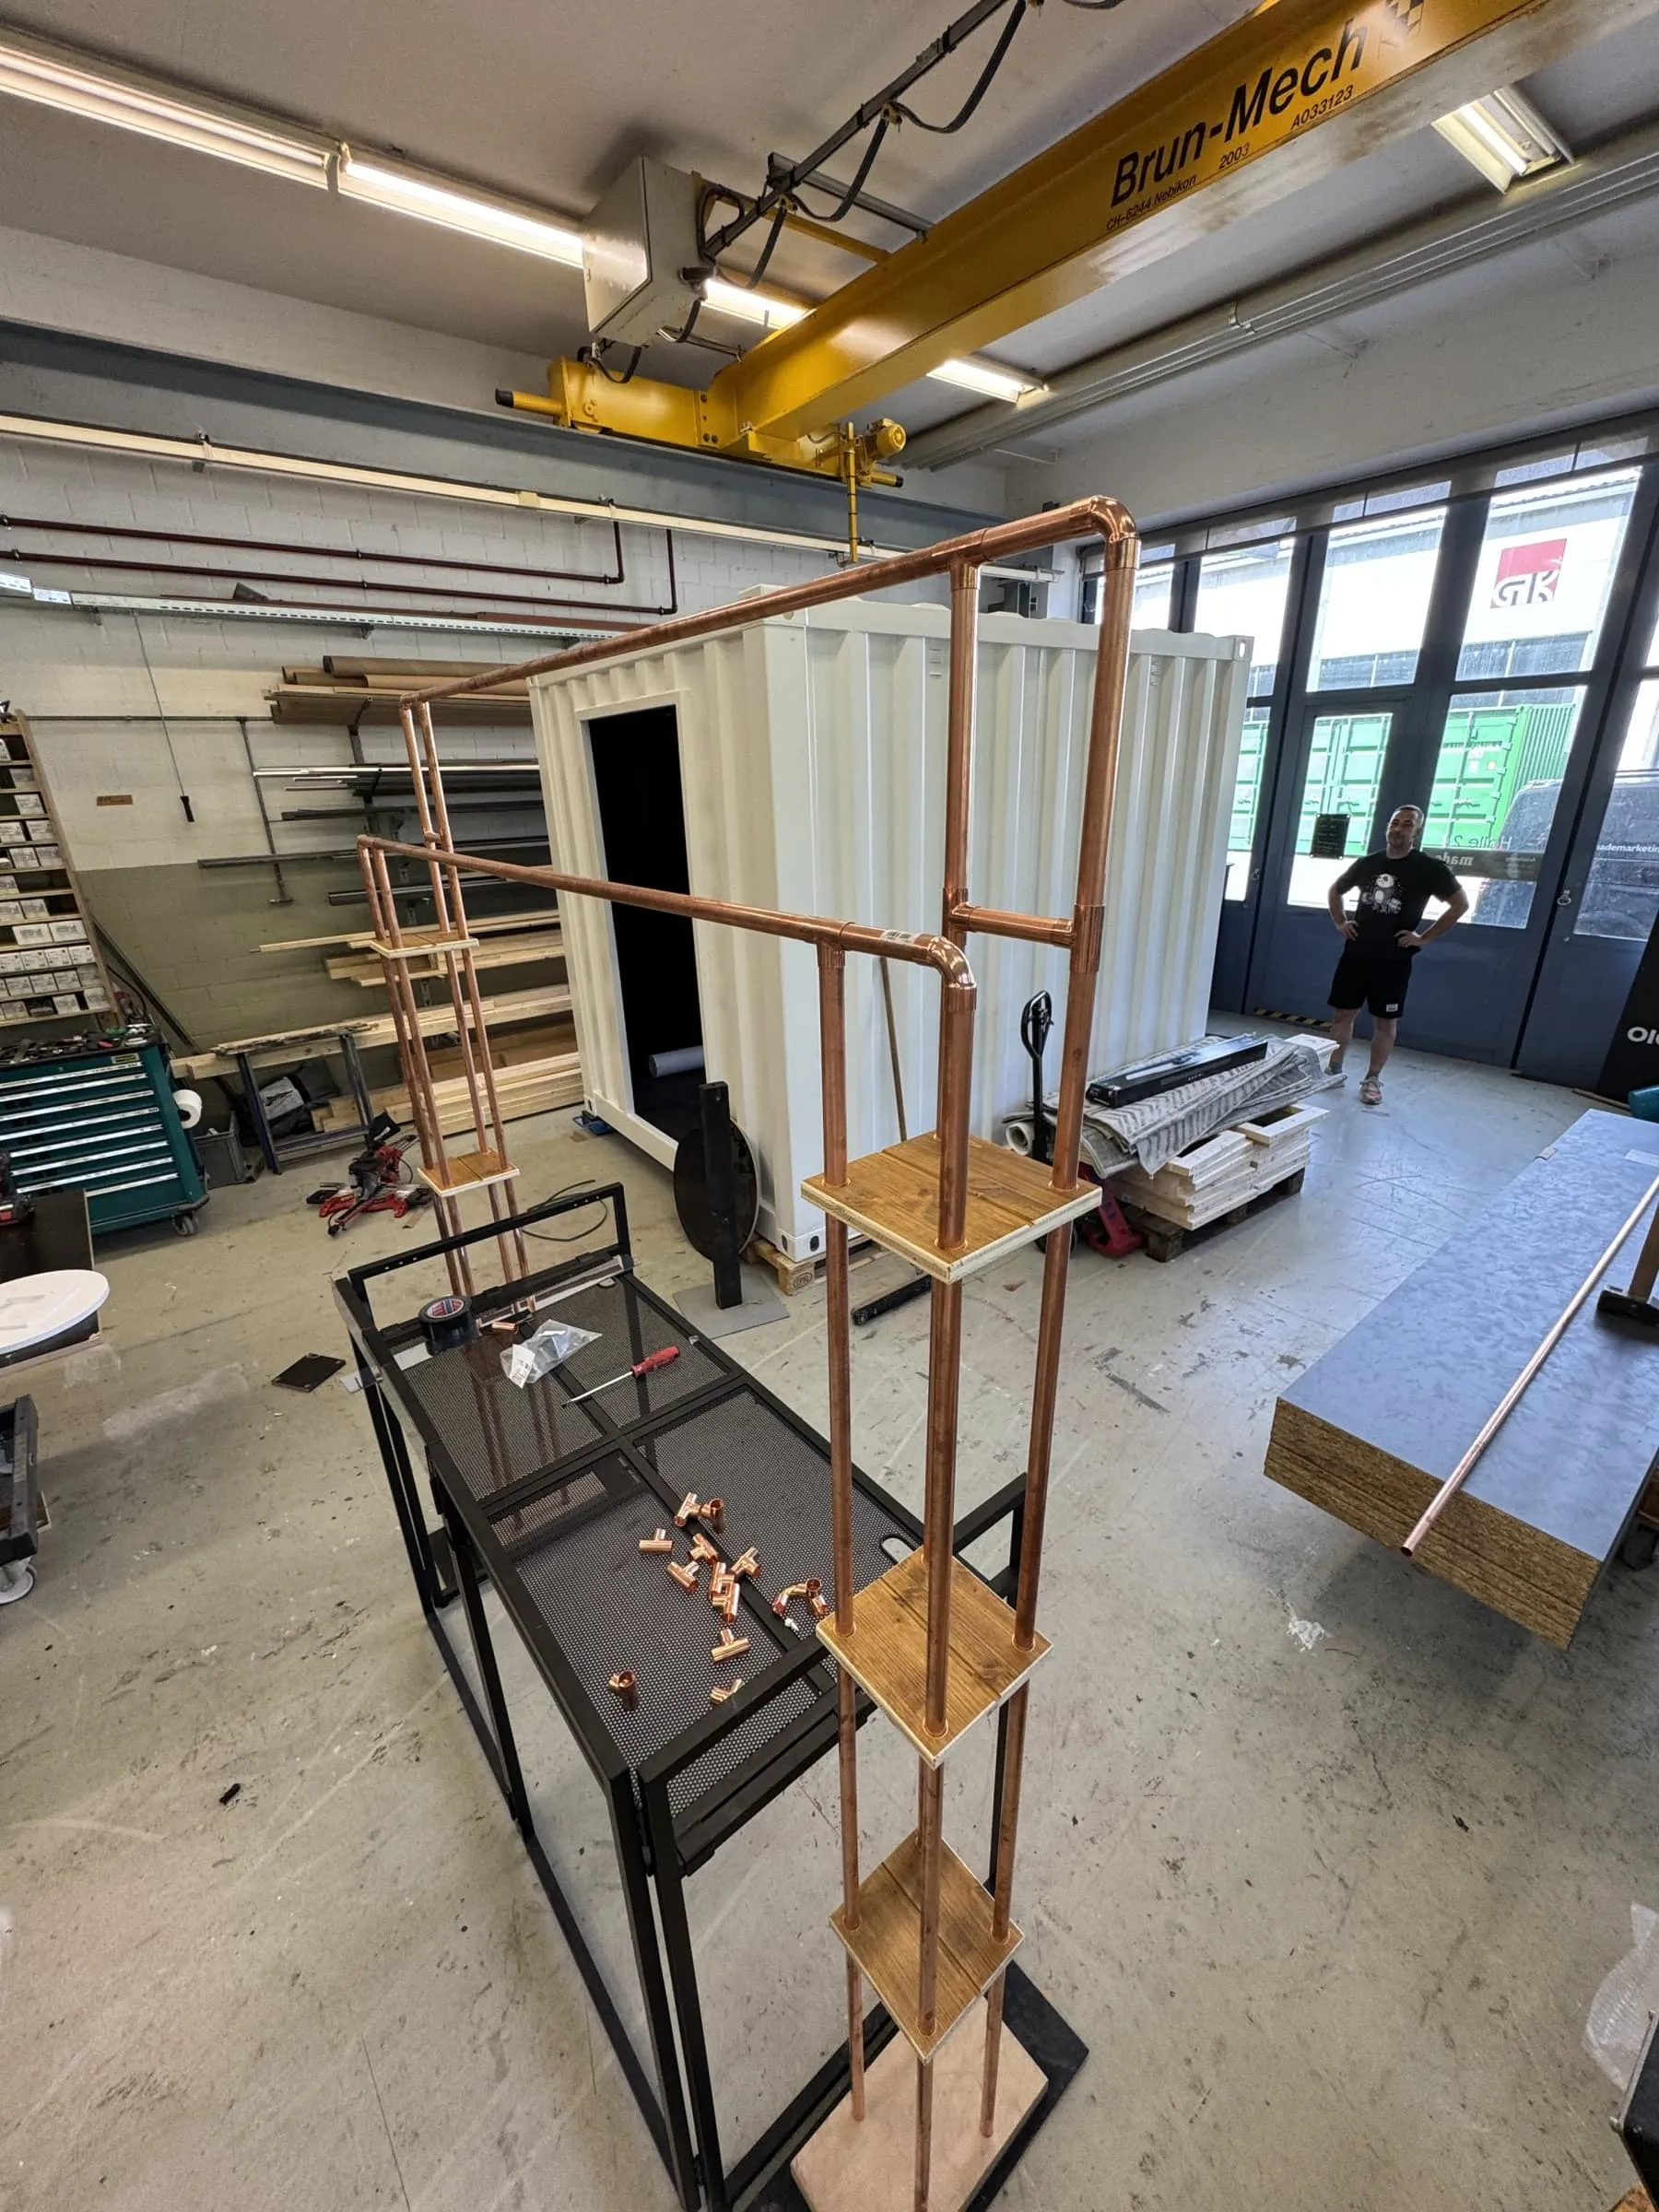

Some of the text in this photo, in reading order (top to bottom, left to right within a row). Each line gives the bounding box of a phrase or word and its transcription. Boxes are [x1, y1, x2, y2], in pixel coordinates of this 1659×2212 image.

[1106, 84, 1353, 231] CH-6244 Nebikon 2003 A033123
[1111, 18, 1368, 208] Brun-Mech
